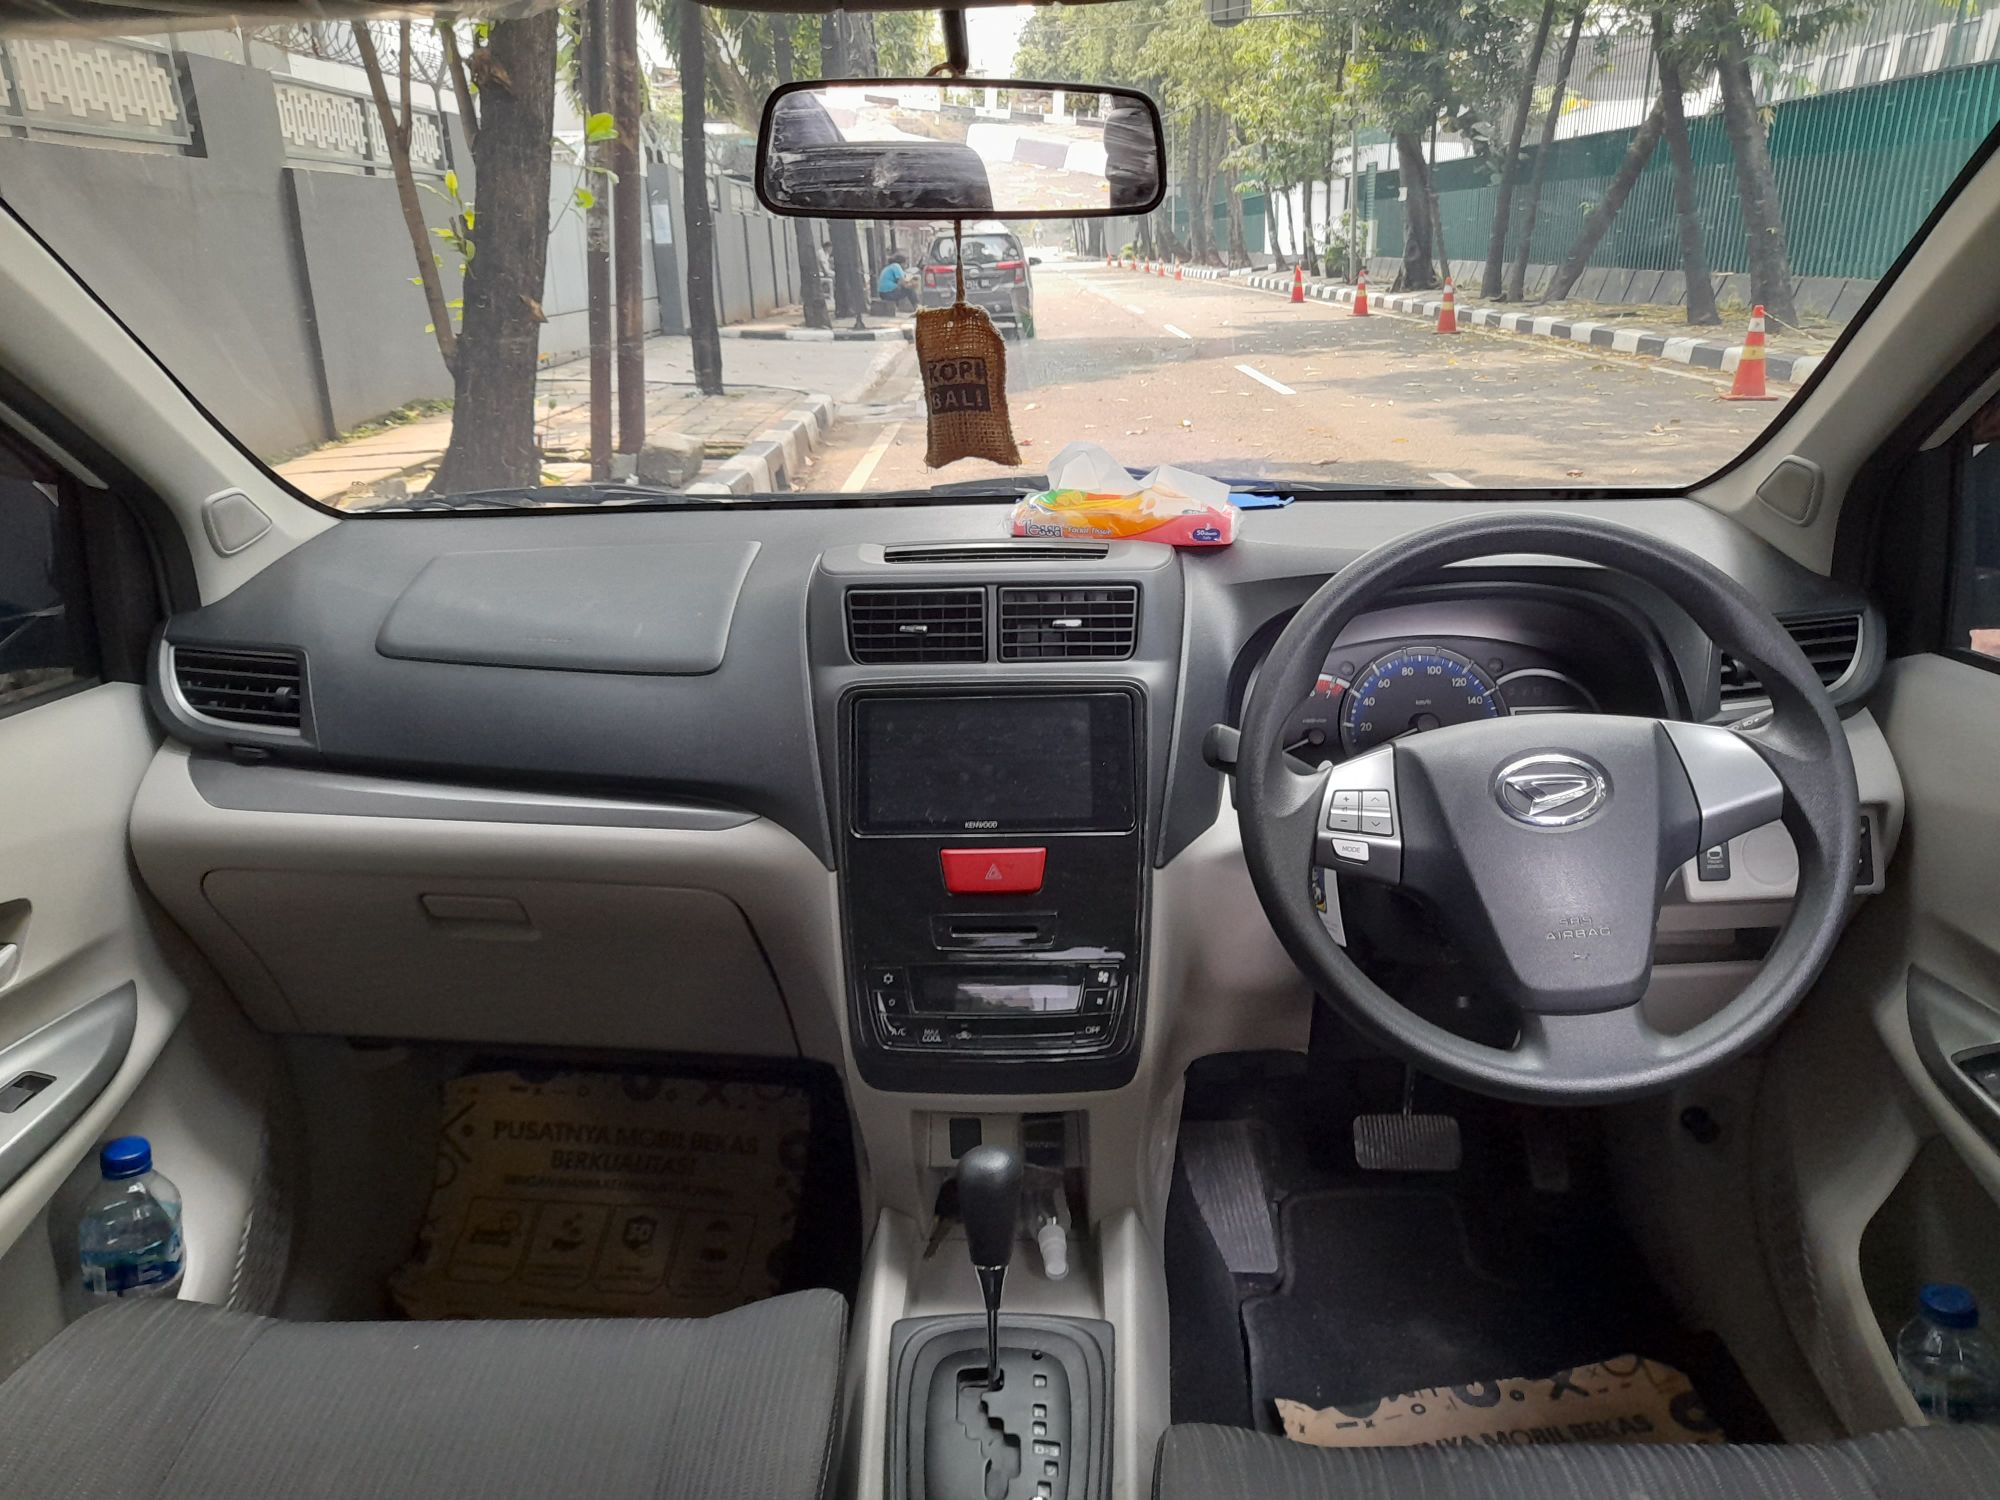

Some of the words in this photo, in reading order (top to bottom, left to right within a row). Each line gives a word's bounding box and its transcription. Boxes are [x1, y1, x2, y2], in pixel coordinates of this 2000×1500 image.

[928, 361, 983, 384] KOPI
[1022, 519, 1062, 537] Tessa
[1402, 666, 1414, 676] 80
[1427, 666, 1442, 675] 100
[1378, 678, 1390, 688] 60
[1452, 677, 1467, 687] 120
[1363, 697, 1375, 706] 40
[1467, 696, 1483, 705] 140
[1360, 722, 1373, 732] 20
[965, 820, 998, 829] KENWOOD
[1341, 845, 1361, 854] MODE
[1545, 927, 1612, 941] AIRBAG
[891, 1027, 906, 1037] A/C
[1085, 1025, 1101, 1035] OFF
[493, 1119, 610, 1145] PUSATNYA
[1567, 1414, 1655, 1442] BEKAS
